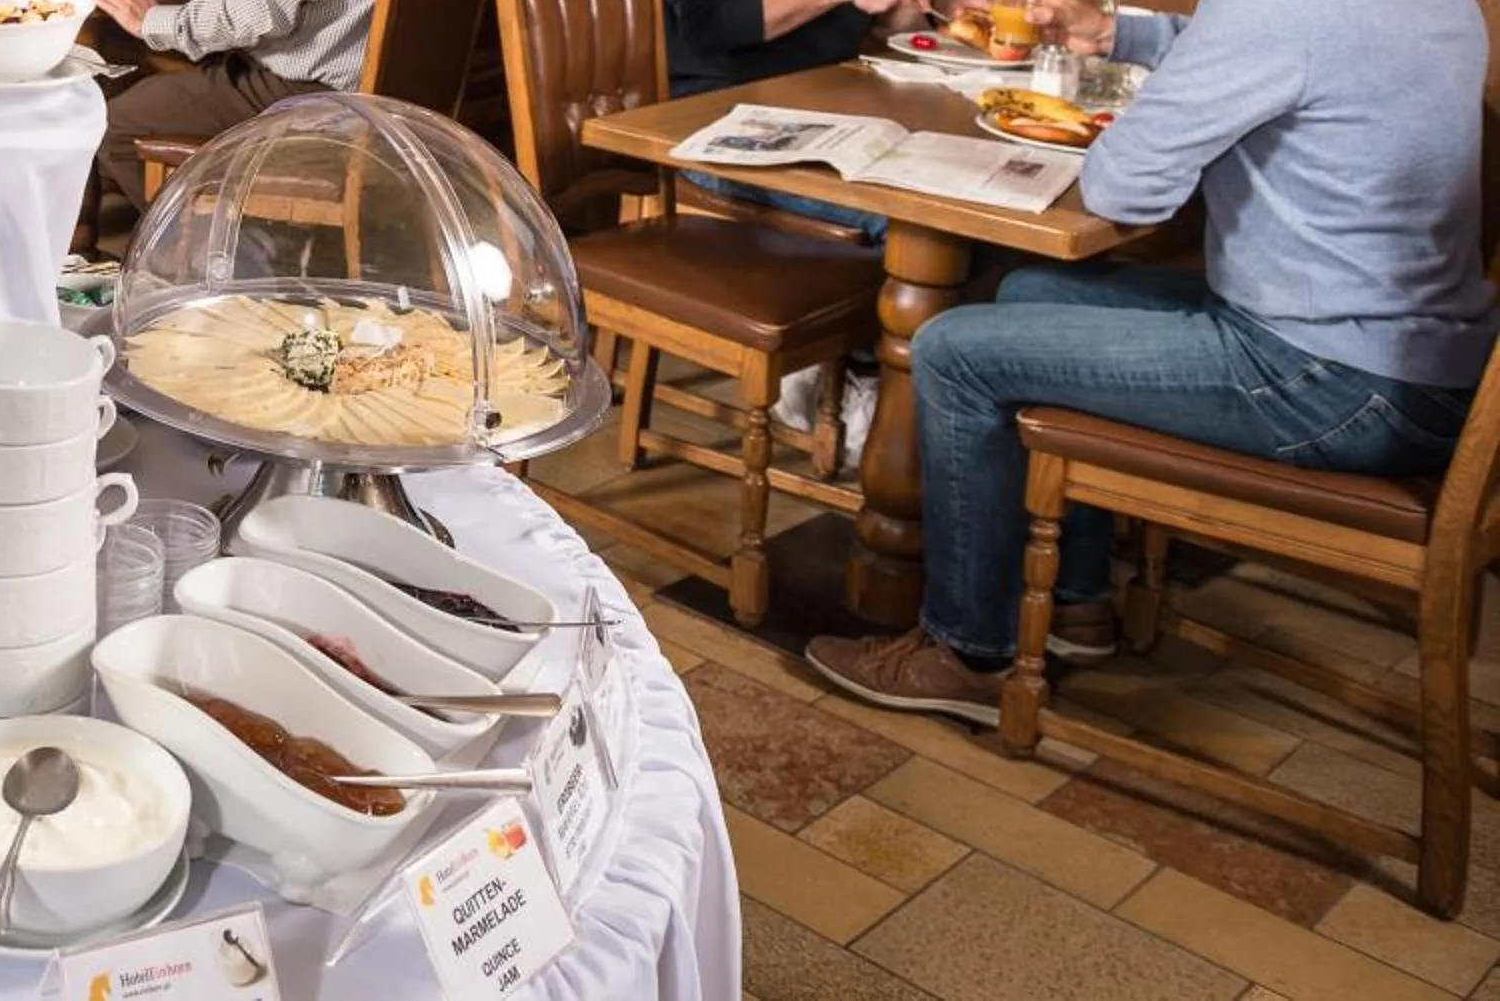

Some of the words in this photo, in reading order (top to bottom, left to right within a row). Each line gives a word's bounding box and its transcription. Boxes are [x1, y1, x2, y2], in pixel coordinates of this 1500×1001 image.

[451, 889, 527, 956] MARMELADE
[453, 877, 507, 925] QUITTEN-
[481, 938, 523, 977] QUINCE
[499, 966, 521, 992] JAM
